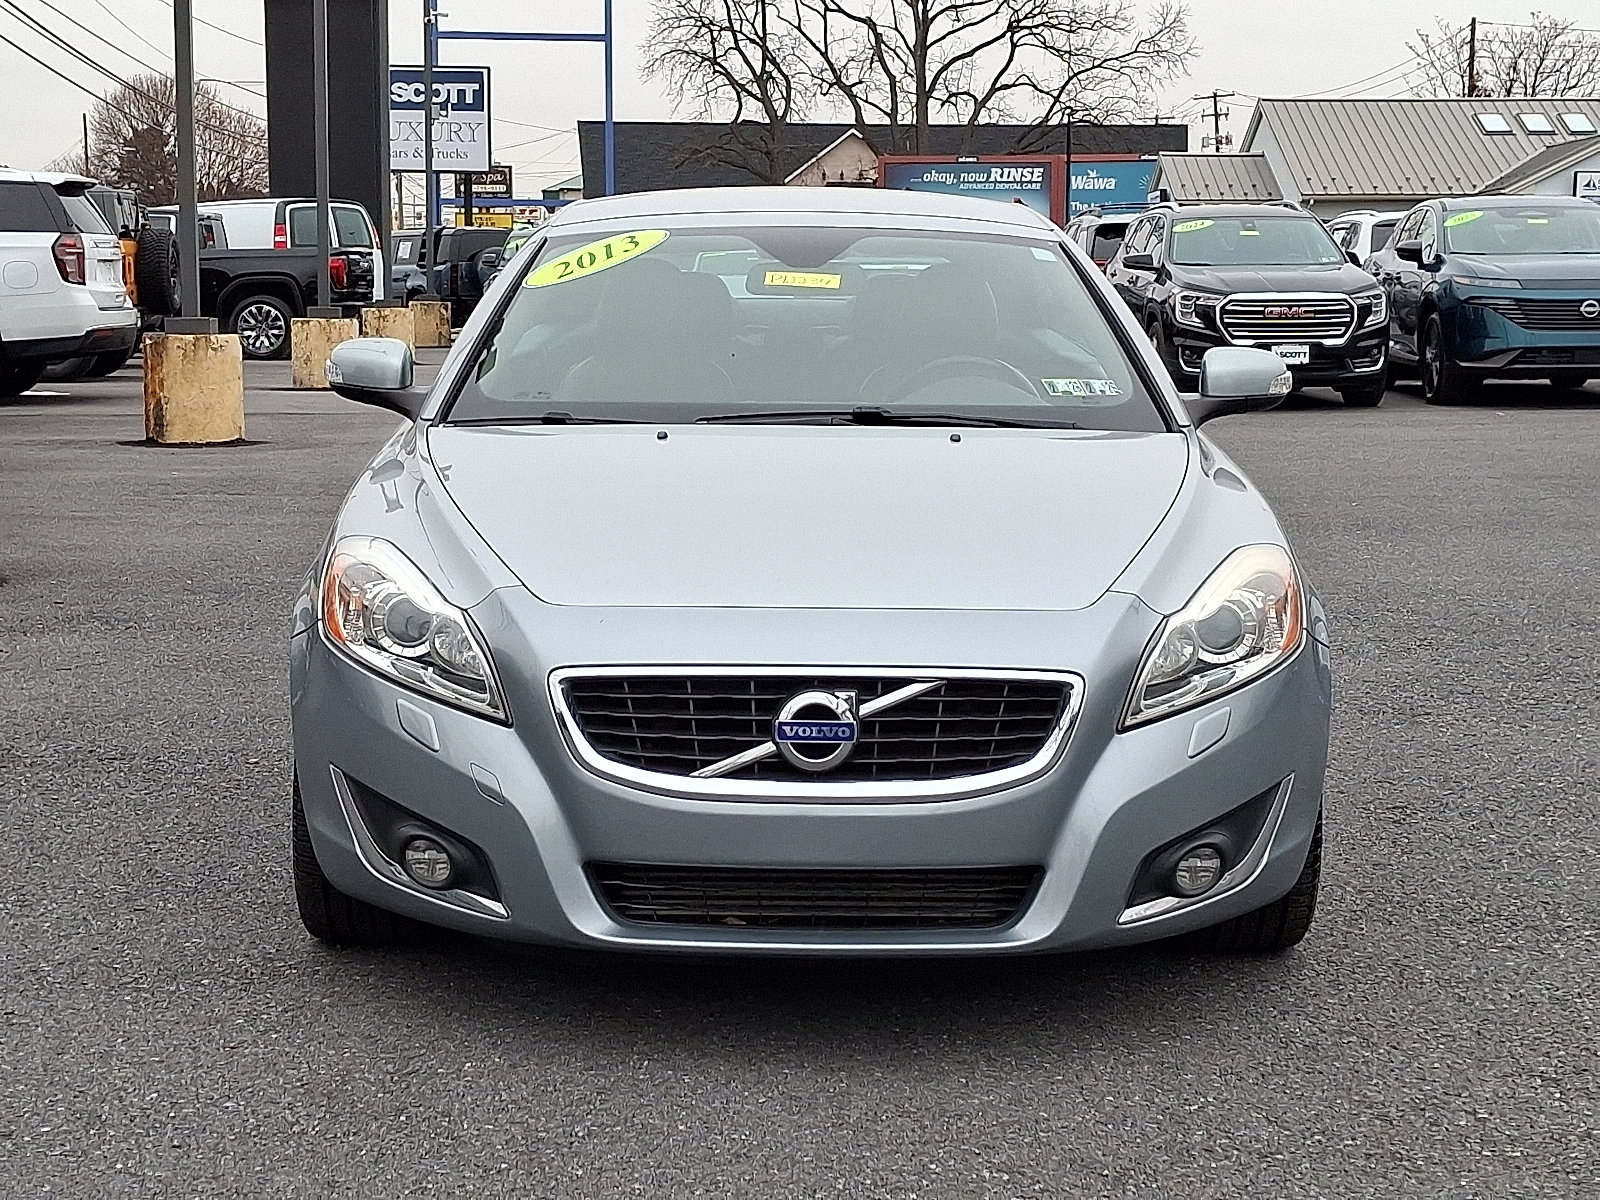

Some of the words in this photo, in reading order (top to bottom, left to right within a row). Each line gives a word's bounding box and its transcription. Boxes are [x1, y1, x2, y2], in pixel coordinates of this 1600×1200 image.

[390, 81, 480, 104] SCOTT
[389, 120, 484, 143] UXURY
[390, 149, 408, 159] ars
[412, 146, 424, 159] &
[960, 171, 988, 183] now
[988, 166, 1044, 183] RINSE
[958, 182, 995, 190] ADVANCED
[995, 182, 1022, 190] DENTAL
[1070, 174, 1116, 190] Wawa
[1070, 200, 1089, 211] The
[552, 234, 640, 280] 2013
[1264, 306, 1316, 318] GMC
[1279, 351, 1308, 359] SCOTT
[781, 725, 851, 738] VOLVO
